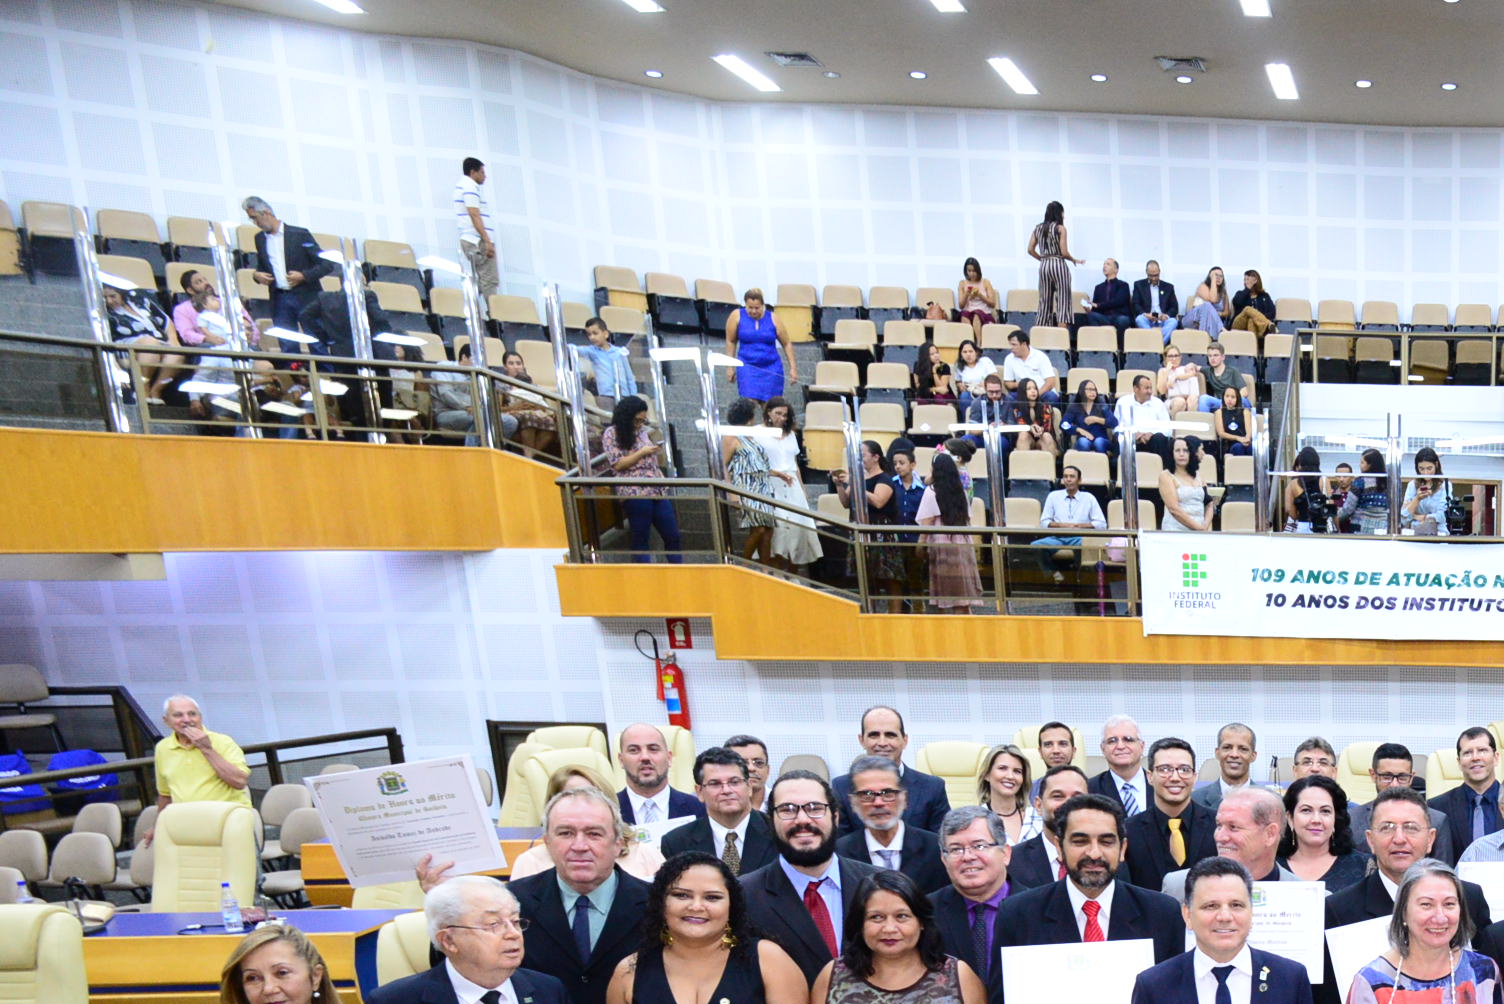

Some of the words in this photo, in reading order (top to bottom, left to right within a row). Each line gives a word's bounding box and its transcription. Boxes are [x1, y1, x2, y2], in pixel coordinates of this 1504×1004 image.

[1251, 568, 1285, 583] 109
[1290, 569, 1349, 585] ANOS
[1354, 571, 1383, 586] DE
[1385, 570, 1488, 590] ATUAÇÃO
[1169, 591, 1221, 600] INSTITUTO
[1265, 593, 1286, 608] 10
[1291, 594, 1350, 609] ANOS
[1355, 595, 1398, 610] DOS
[1174, 600, 1216, 609] FEDERAL
